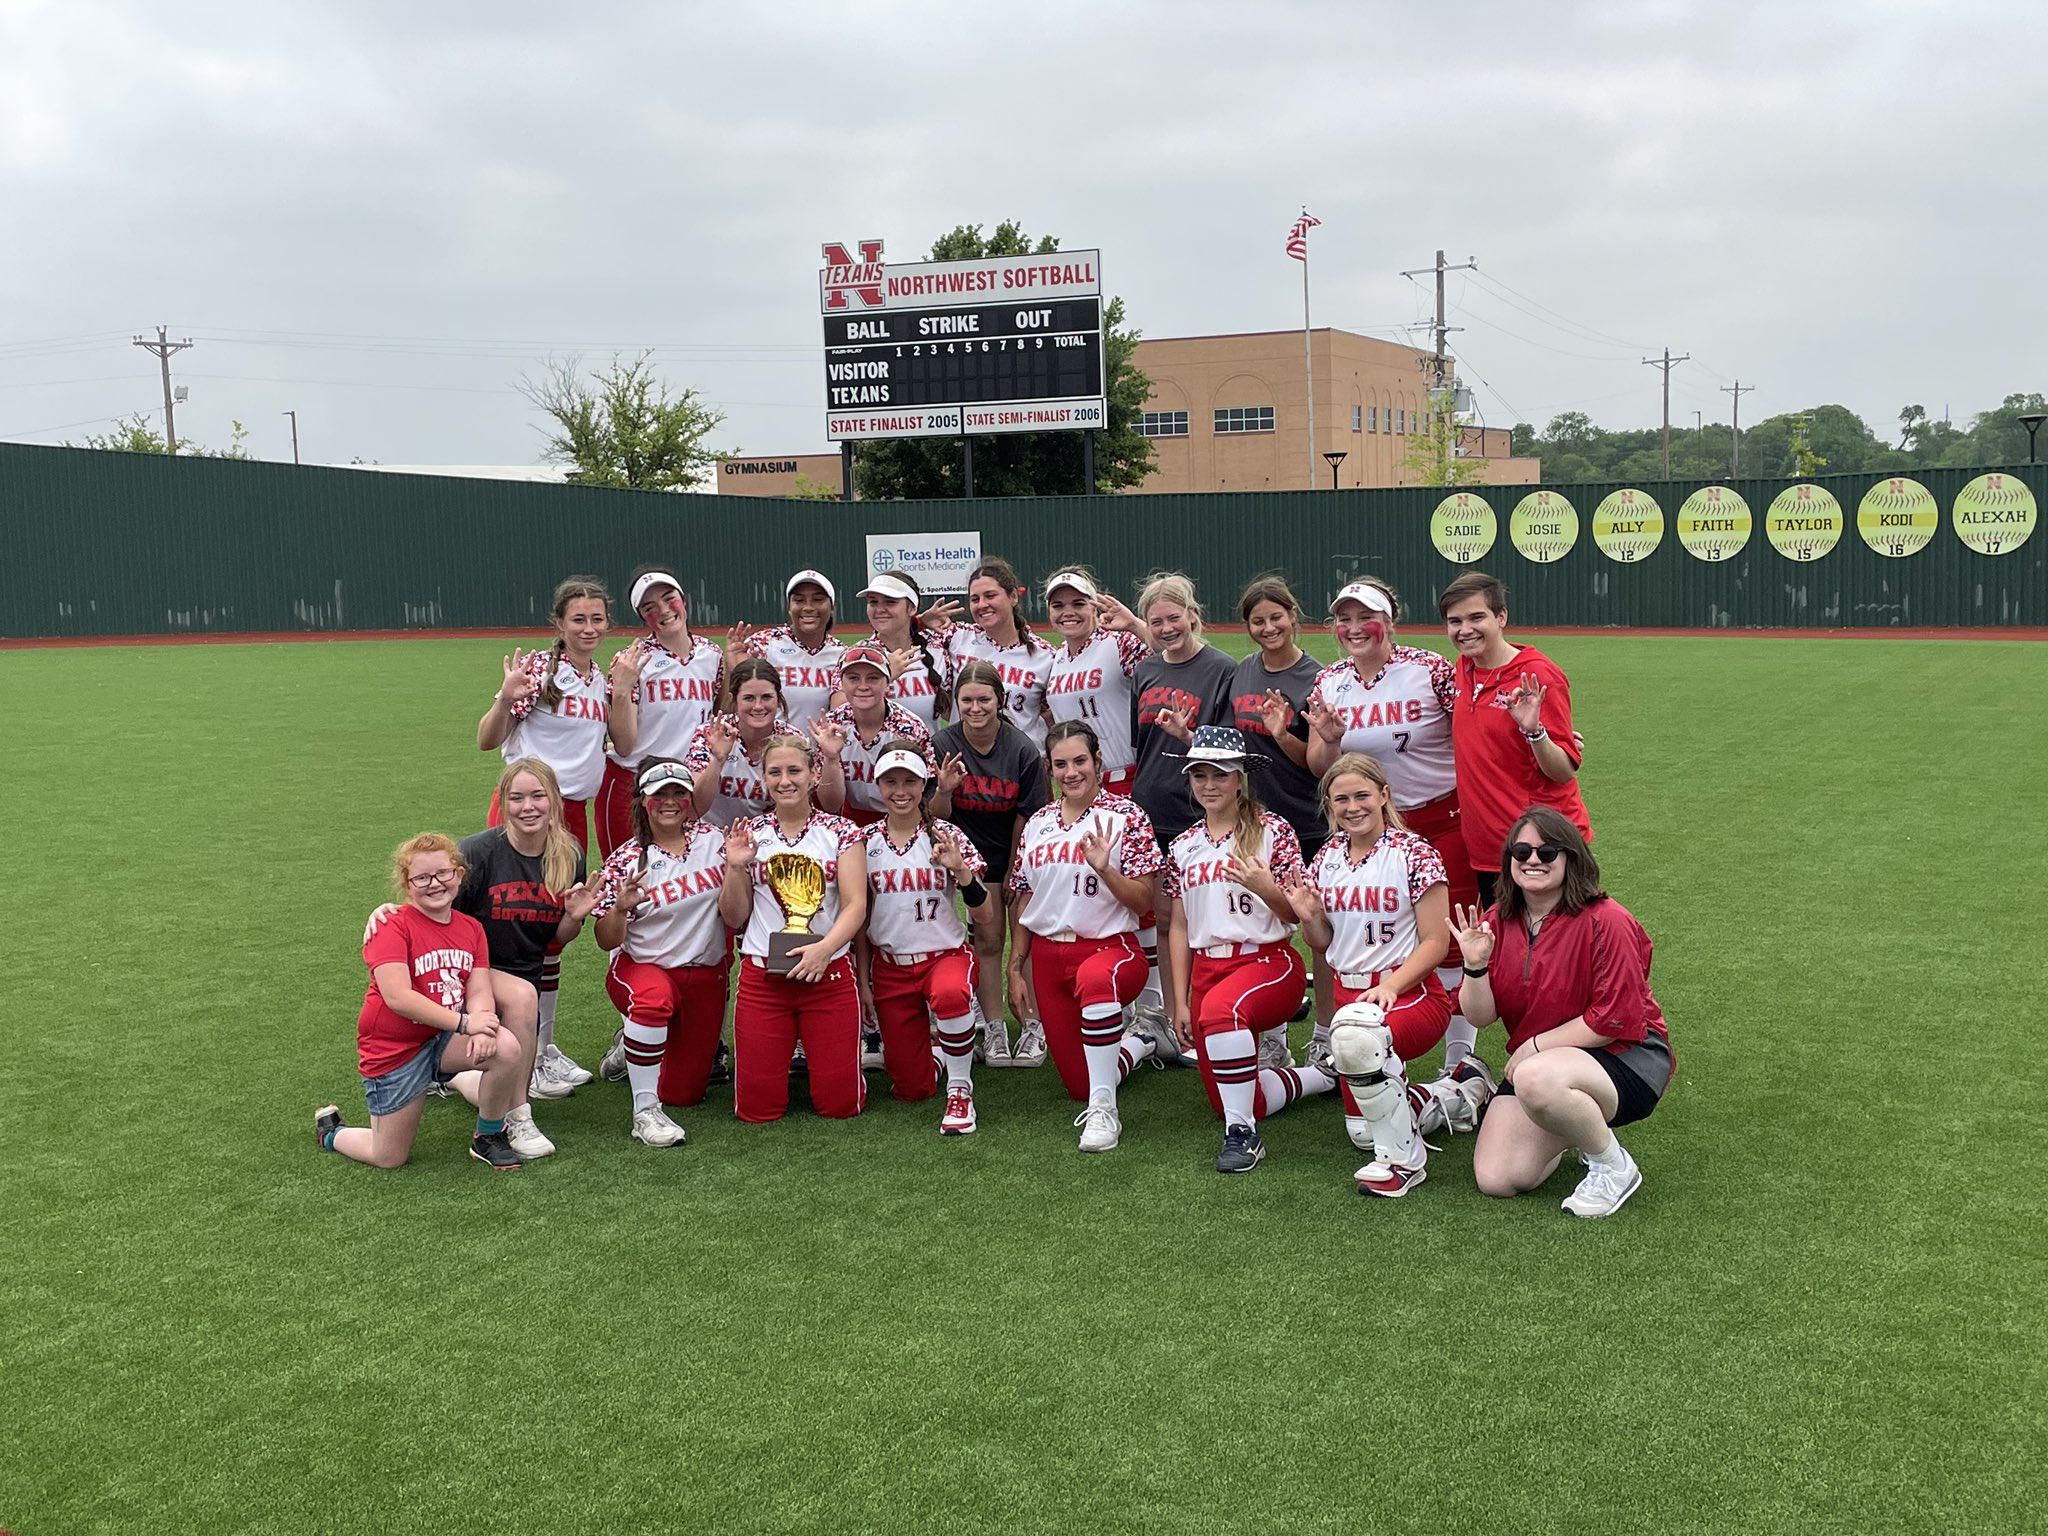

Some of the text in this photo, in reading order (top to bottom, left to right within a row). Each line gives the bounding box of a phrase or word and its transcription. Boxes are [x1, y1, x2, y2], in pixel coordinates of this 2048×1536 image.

[825, 263, 885, 284] TEXANS
[888, 263, 1095, 297] NORTHWEST SOFTBALL
[846, 309, 1052, 339] BALL STRIKE OUT
[896, 335, 1087, 357] 1 2 3 4 5 6 7 8 9 TOTAL
[828, 361, 889, 381] VISITOR
[831, 385, 890, 404] TEXANS
[831, 414, 958, 433] STATE FINALIST 2005
[966, 408, 1100, 426] STATE SEMI-FINALIST 2006
[725, 461, 797, 474] GYMNASIUM
[1692, 520, 1734, 531] FAITH
[1775, 519, 1833, 531] TAYLOR
[1880, 514, 1913, 526] KODI
[1961, 510, 2027, 524] ALEXAH
[1445, 525, 1482, 536] SADIE
[1526, 523, 1562, 536] JOSIE
[1611, 521, 1645, 534] ALLY
[897, 546, 976, 561] Texas Health
[1457, 551, 1470, 562] 10
[1538, 550, 1549, 561] 11
[1621, 550, 1634, 561] 12
[1707, 549, 1720, 560] 13
[1797, 549, 1811, 560] 15
[1889, 544, 1904, 556] 16
[1986, 542, 2001, 553] 17
[899, 561, 966, 572] Sports Medicine
[778, 666, 833, 688] EXA
[956, 653, 1037, 690] TANS
[1046, 667, 1103, 696] EXANS
[646, 677, 714, 703] TEXAN
[552, 694, 608, 724] EXA
[1003, 690, 1027, 713] 13
[1079, 695, 1100, 719] 11
[1338, 698, 1422, 731] EXANS
[1392, 730, 1411, 753] 7
[1027, 841, 1086, 869] EXAN
[649, 863, 726, 909] TEXAN
[870, 867, 946, 894] EXANS
[1072, 872, 1101, 898] 18
[914, 897, 941, 922] 17
[1227, 892, 1254, 916] 16
[1364, 920, 1397, 947] 15
[414, 948, 474, 977] NORTHWE
